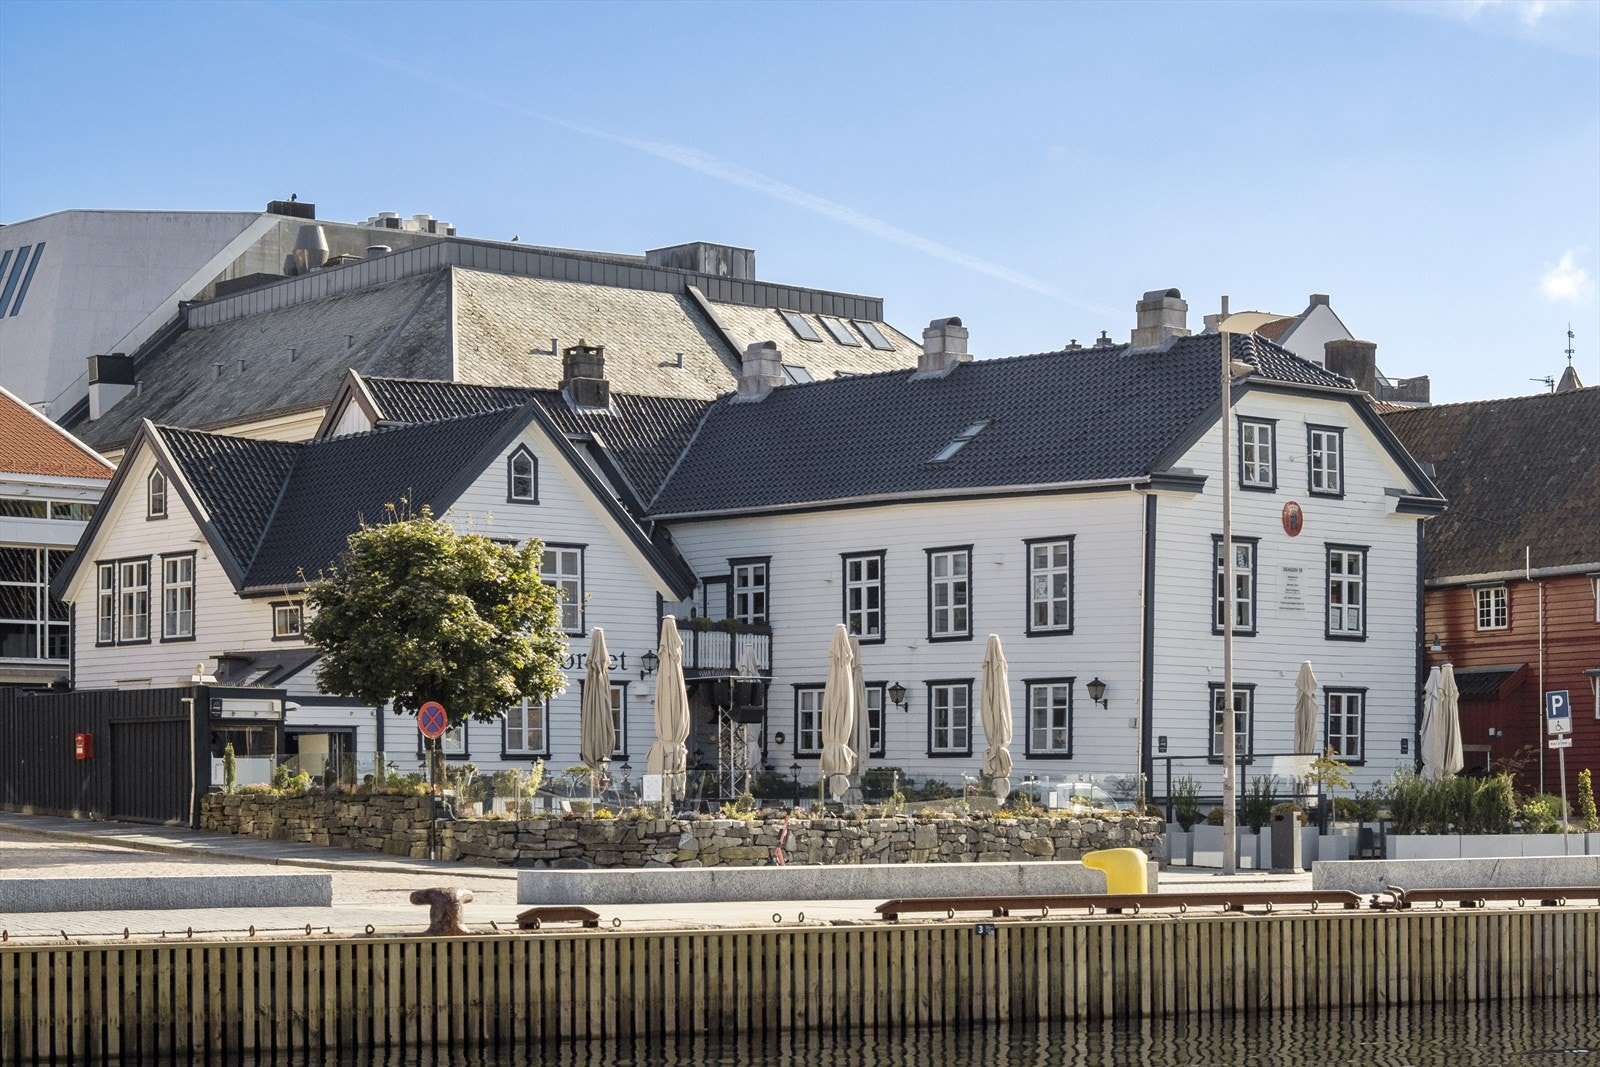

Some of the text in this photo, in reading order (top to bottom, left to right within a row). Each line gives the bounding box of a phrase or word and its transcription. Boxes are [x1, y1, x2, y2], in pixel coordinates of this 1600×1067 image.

[559, 650, 628, 671] øret
[1552, 695, 1563, 715] P
[977, 925, 984, 934] 3
